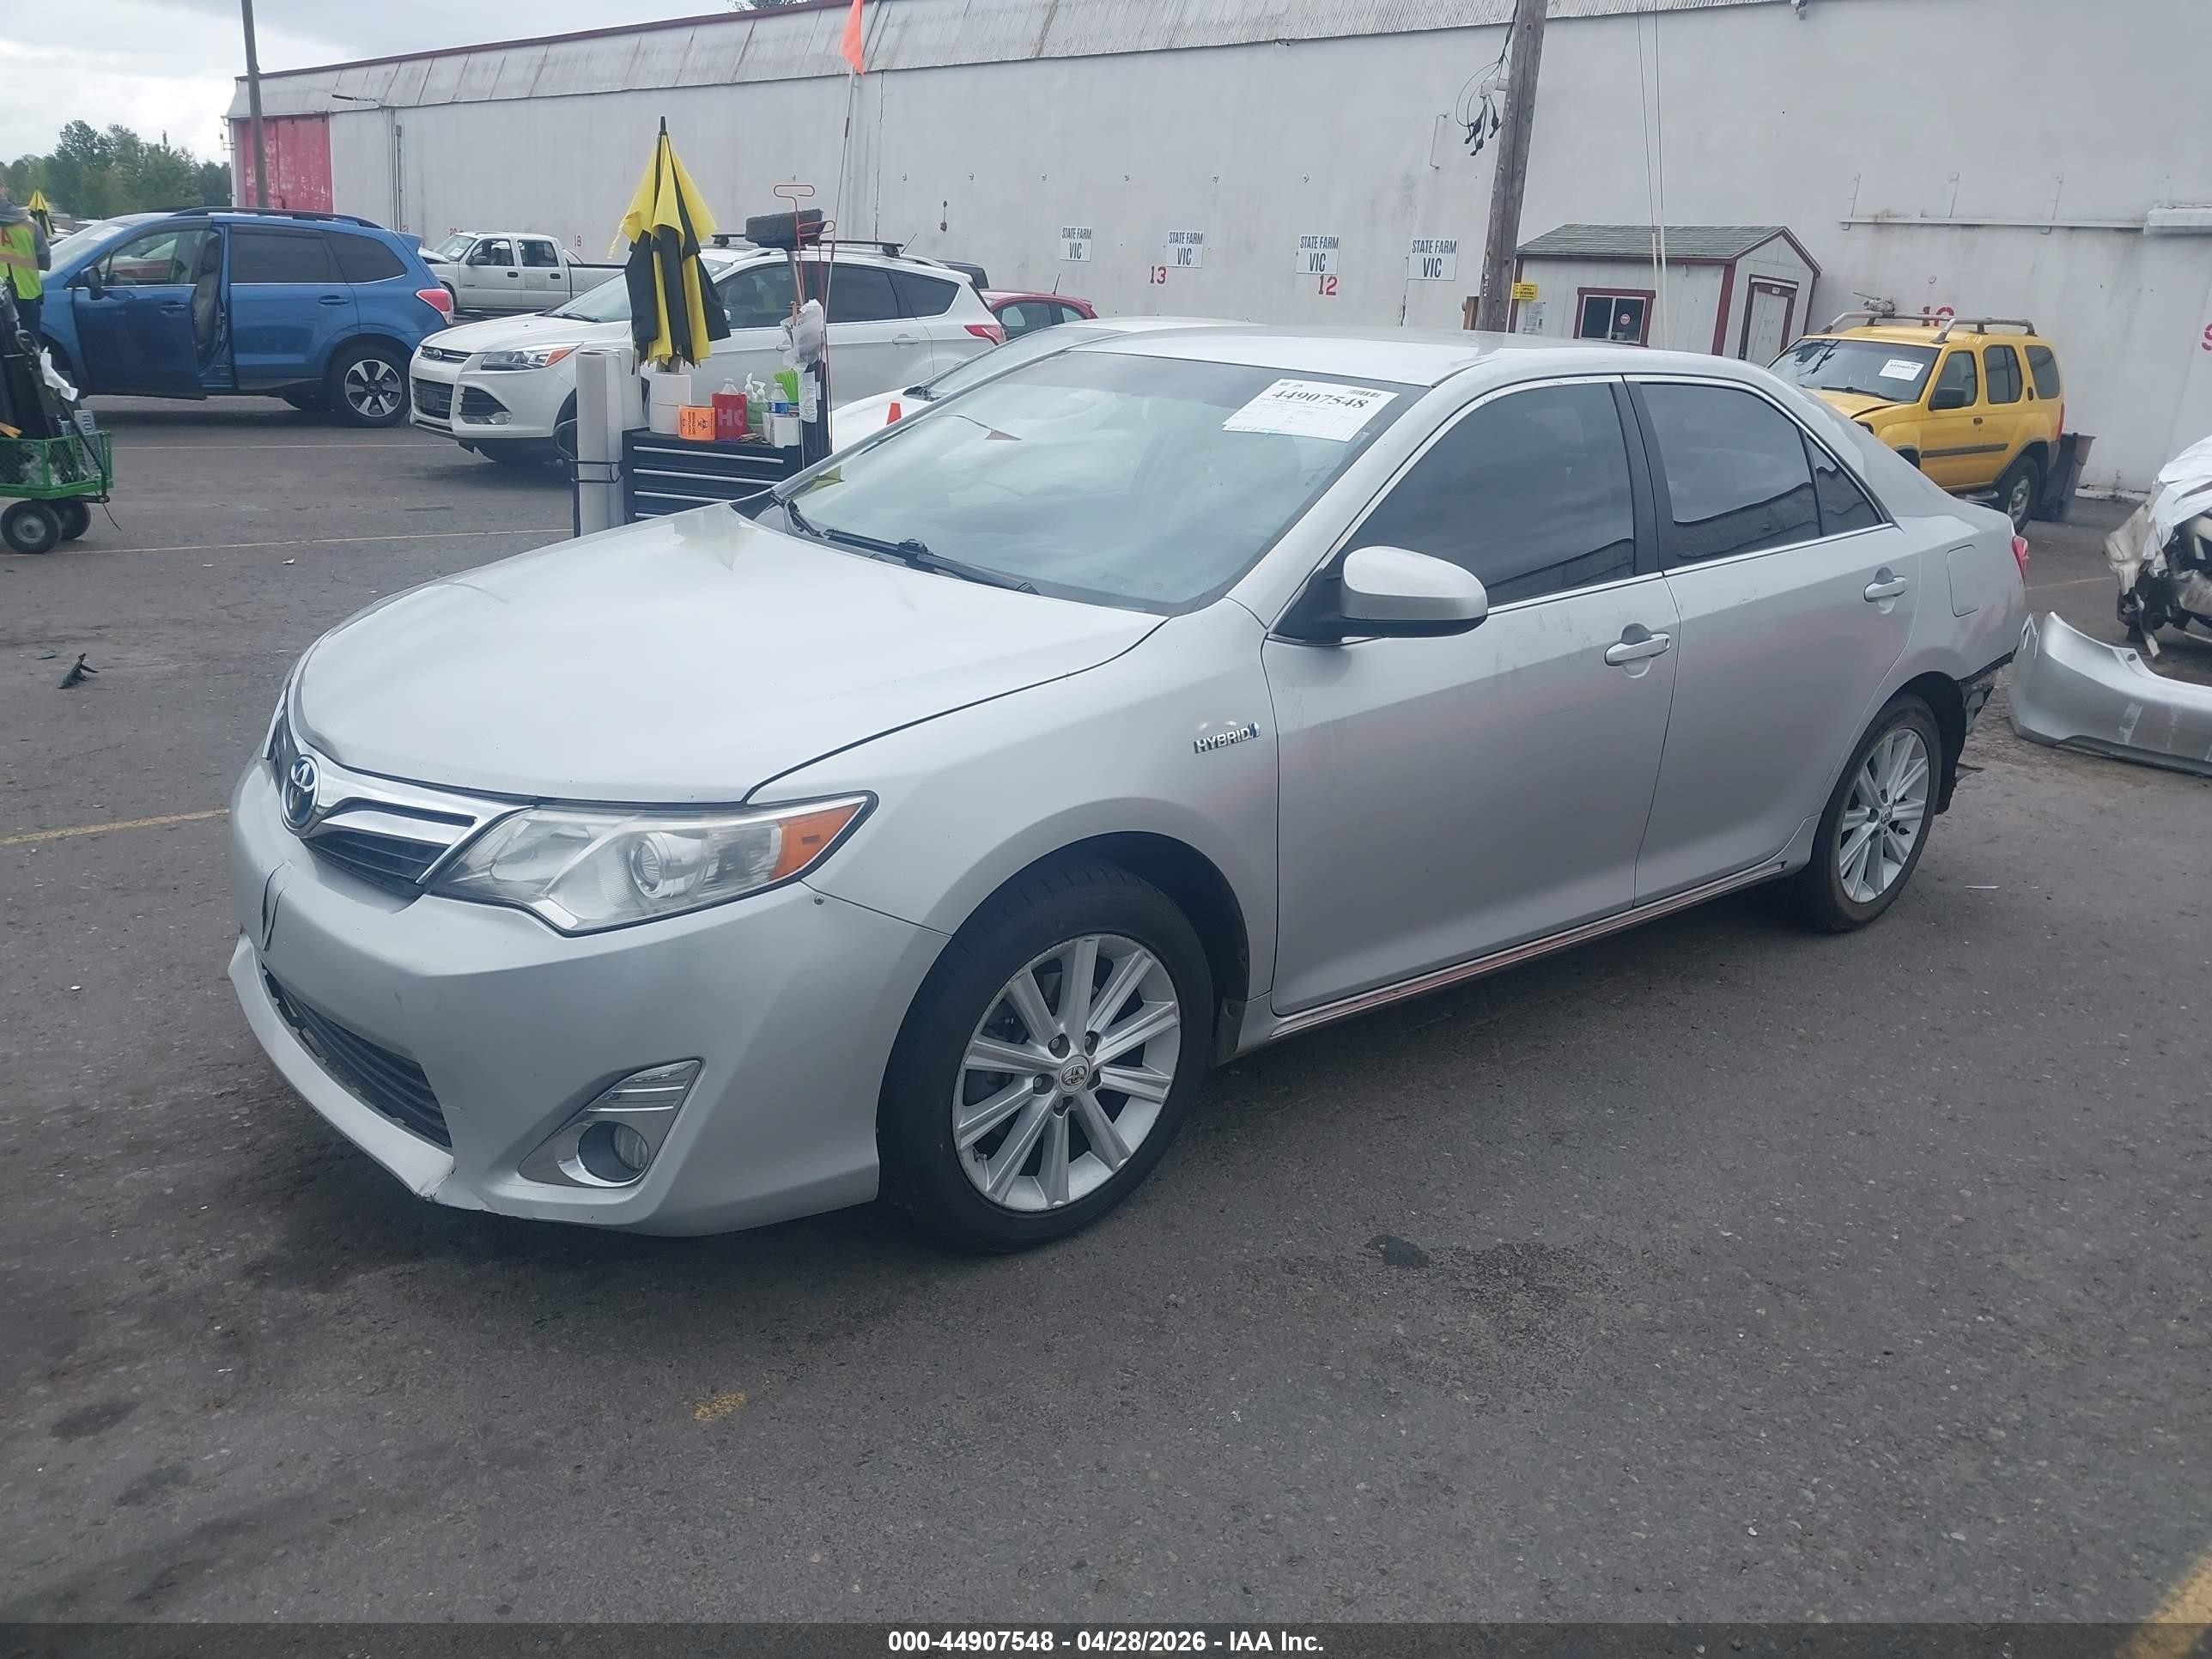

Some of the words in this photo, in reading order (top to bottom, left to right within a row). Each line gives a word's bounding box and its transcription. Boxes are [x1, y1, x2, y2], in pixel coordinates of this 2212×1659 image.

[1061, 227, 1077, 240] STATE
[1076, 228, 1092, 240] FARM
[1168, 231, 1186, 245] STATE
[1186, 232, 1203, 245] FARM
[1299, 235, 1319, 249] STATE
[1319, 236, 1339, 250] FARM
[1069, 242, 1082, 259] VIC
[1177, 247, 1192, 265] VIC
[1412, 240, 1433, 254] STATE
[1434, 240, 1457, 255] FARM
[1310, 252, 1327, 272] VIC
[1423, 258, 1442, 278] VIC
[1150, 265, 1167, 284] 13
[1318, 275, 1338, 295] 12
[1272, 390, 1370, 409] 44907548
[1194, 727, 1252, 754] HYBRID
